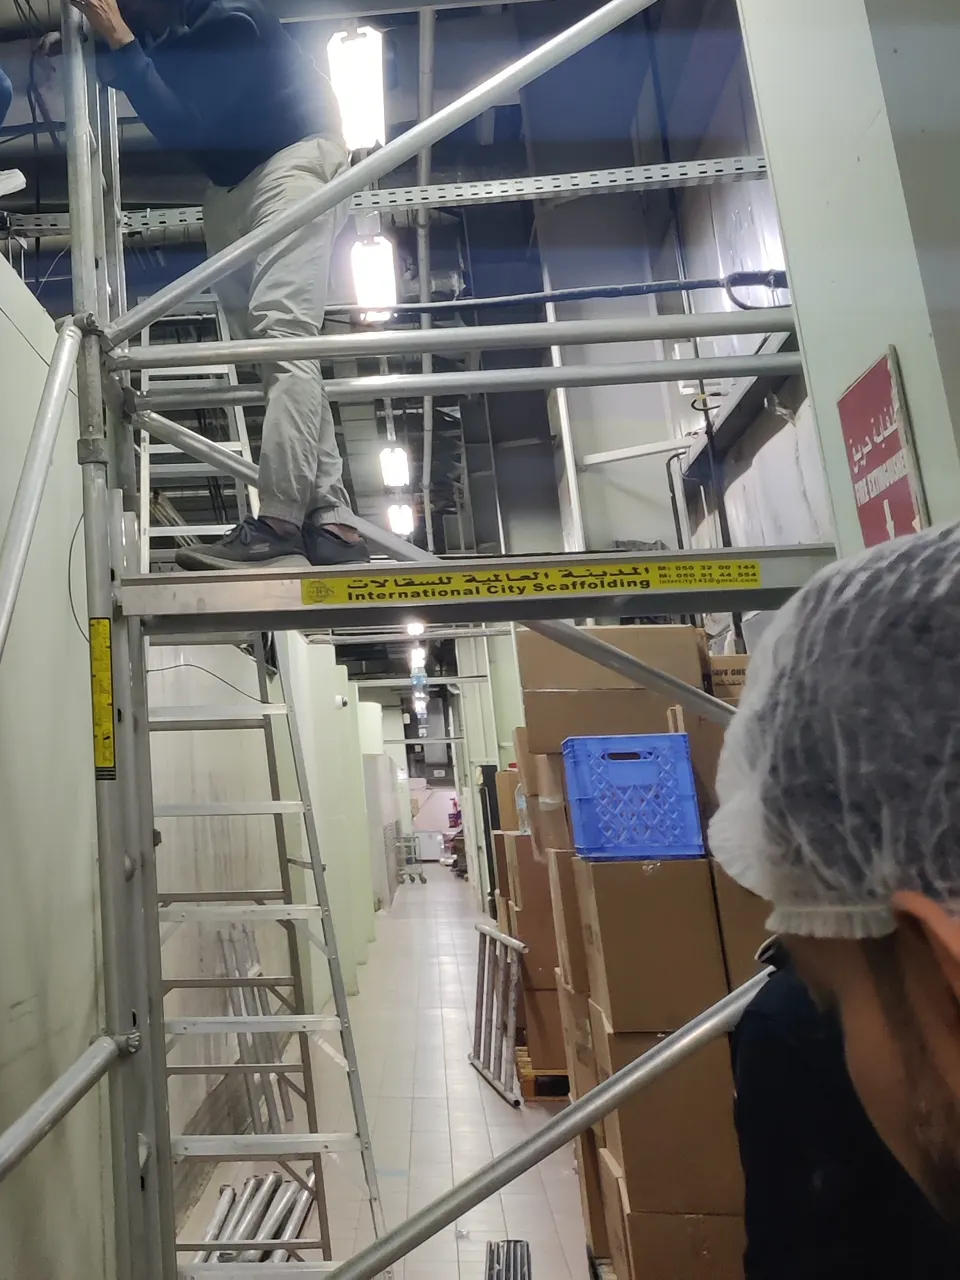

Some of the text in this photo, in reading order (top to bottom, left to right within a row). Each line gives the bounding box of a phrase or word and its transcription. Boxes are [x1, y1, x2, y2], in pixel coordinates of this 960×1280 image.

[347, 578, 650, 601] International City Scaffolding
